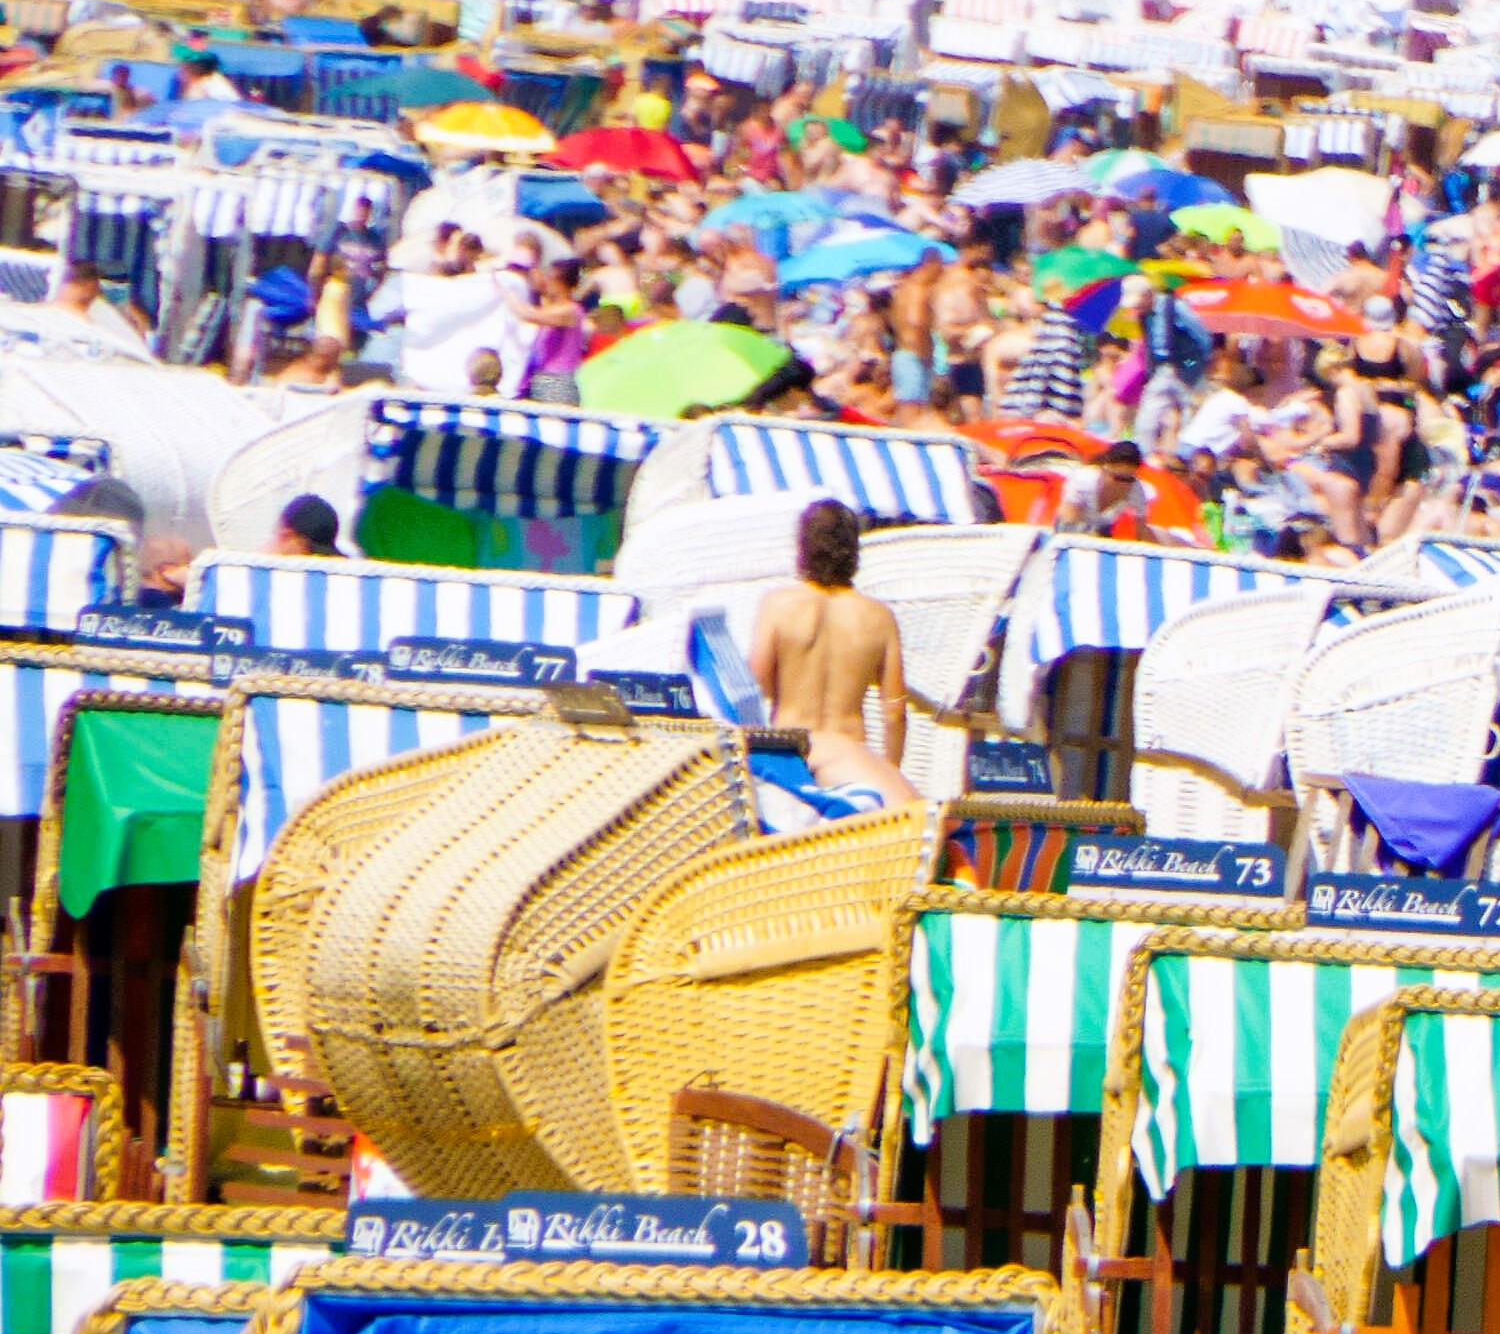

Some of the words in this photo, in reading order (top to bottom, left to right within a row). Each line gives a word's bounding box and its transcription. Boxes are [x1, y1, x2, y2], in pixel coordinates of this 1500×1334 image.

[214, 628, 242, 646] 79
[468, 647, 533, 670] Beach
[533, 657, 566, 681] 77
[1100, 841, 1159, 874] Rikki
[1162, 845, 1236, 874] Beach
[1235, 856, 1272, 886] 73
[1335, 884, 1400, 918] Rikki
[1402, 885, 1478, 916] Beach
[385, 1213, 474, 1255] Rikki
[541, 1203, 625, 1246] Rikki
[633, 1203, 729, 1246] Beach
[733, 1221, 786, 1259] 28
